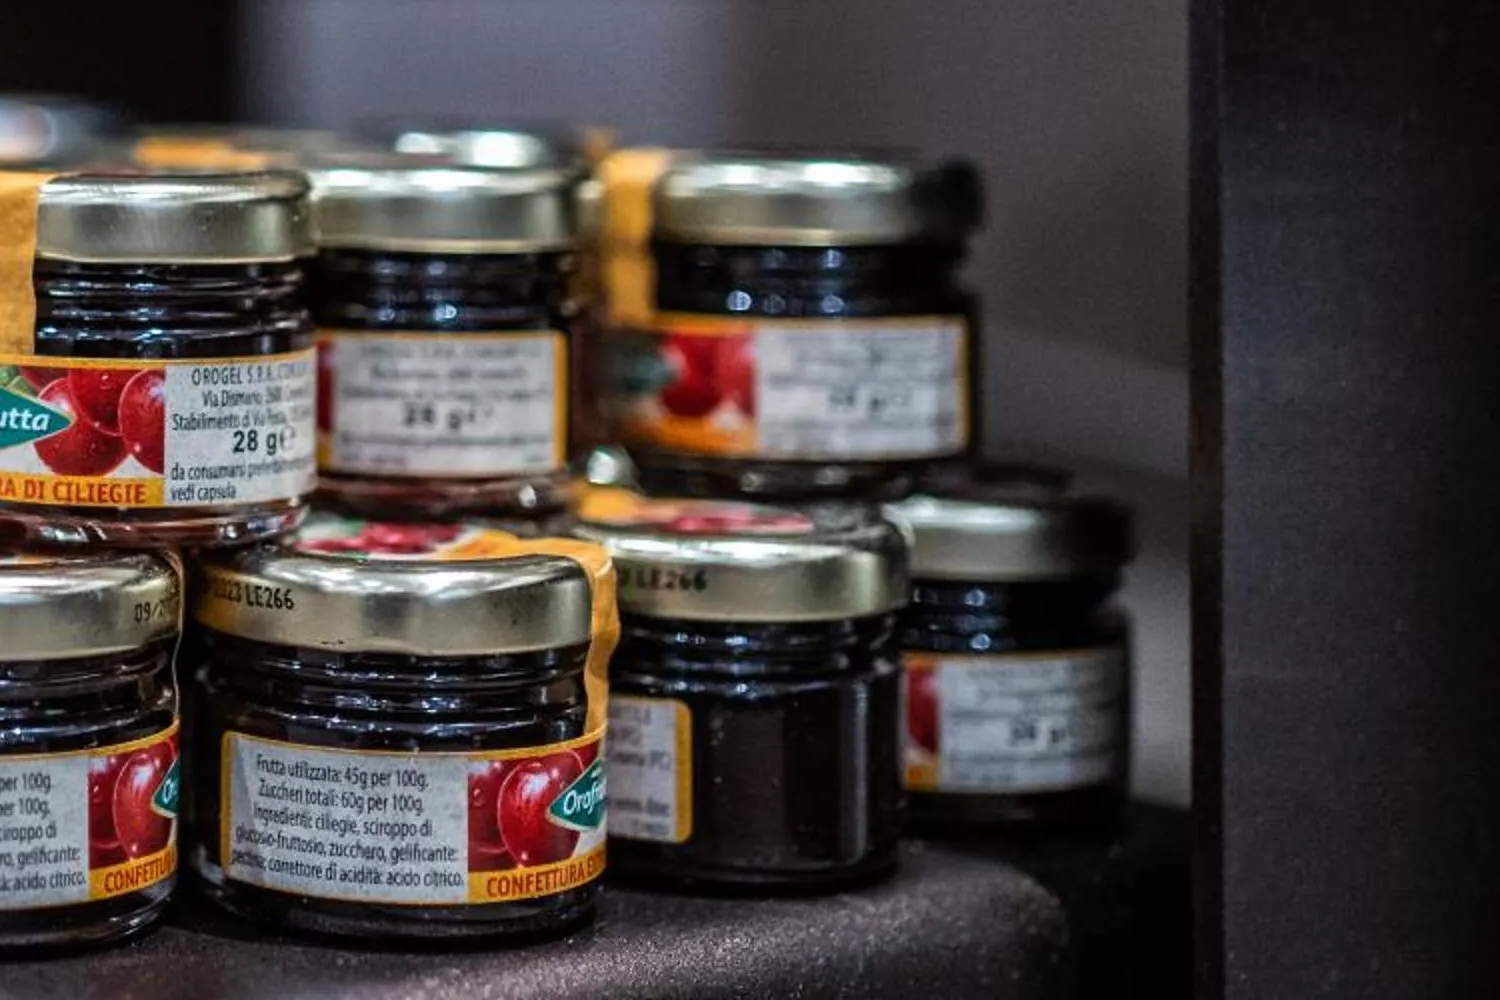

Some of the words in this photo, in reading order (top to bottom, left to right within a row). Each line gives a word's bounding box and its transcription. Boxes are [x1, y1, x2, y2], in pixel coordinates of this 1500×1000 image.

[191, 366, 242, 386] OROGEL
[232, 428, 258, 453] 28
[170, 462, 186, 481] da
[23, 479, 46, 500] DI
[52, 482, 147, 505] CILIEGIE
[169, 483, 195, 501] vedi
[197, 481, 237, 503] capsula
[244, 583, 295, 611] LE266
[256, 753, 286, 776] Frutta
[287, 760, 342, 783] utilizzata:
[343, 767, 368, 791] 45g
[370, 772, 392, 791] per
[395, 768, 429, 793] 100g.
[258, 778, 303, 802] Zuccheri
[305, 787, 339, 808] totali:
[341, 791, 365, 815] 60g
[367, 795, 389, 815] per
[45, 819, 57, 840] di
[363, 816, 417, 841] sciroppo
[419, 818, 433, 838] di
[12, 870, 47, 891] acido
[267, 856, 323, 880] correttore
[325, 859, 337, 881] di
[385, 868, 421, 888] acido
[486, 863, 585, 898] CONFETTURA
